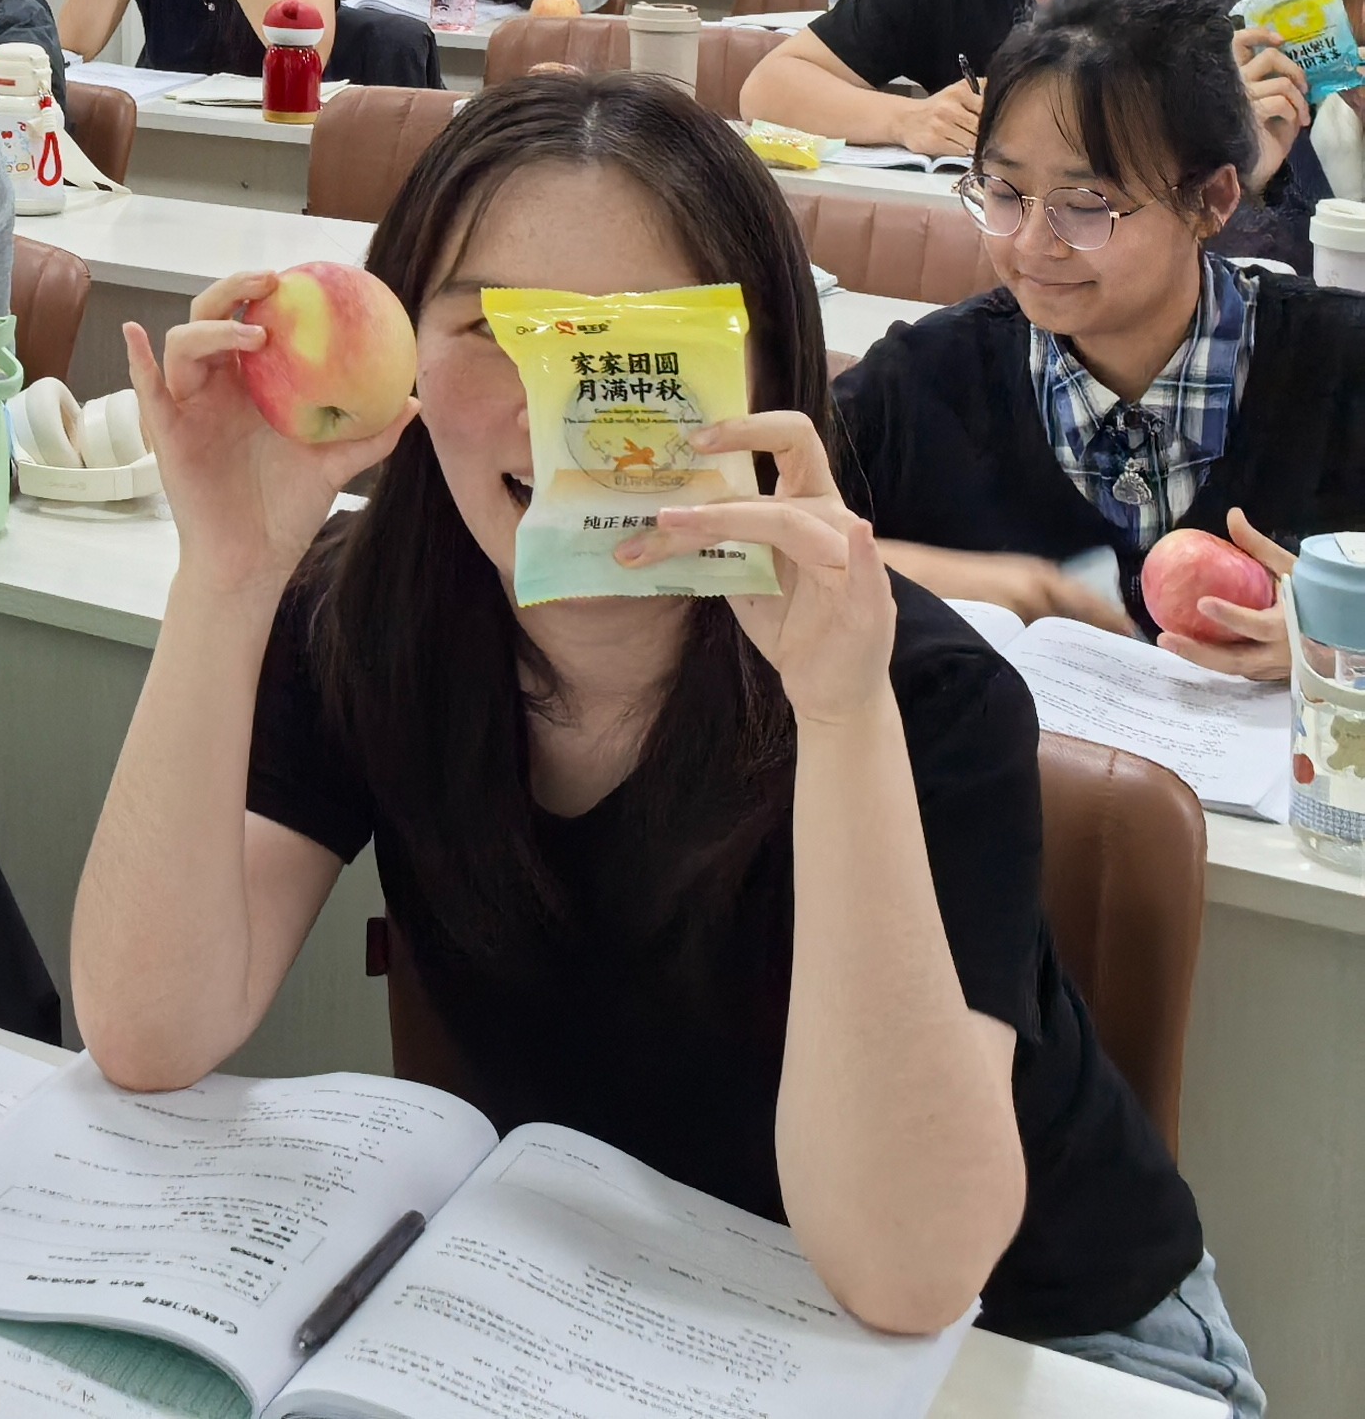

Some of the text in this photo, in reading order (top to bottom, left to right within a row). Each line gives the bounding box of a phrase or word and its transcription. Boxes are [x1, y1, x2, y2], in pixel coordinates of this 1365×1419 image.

[570, 351, 680, 376] 家家团圆
[576, 377, 687, 404] 月满中秋
